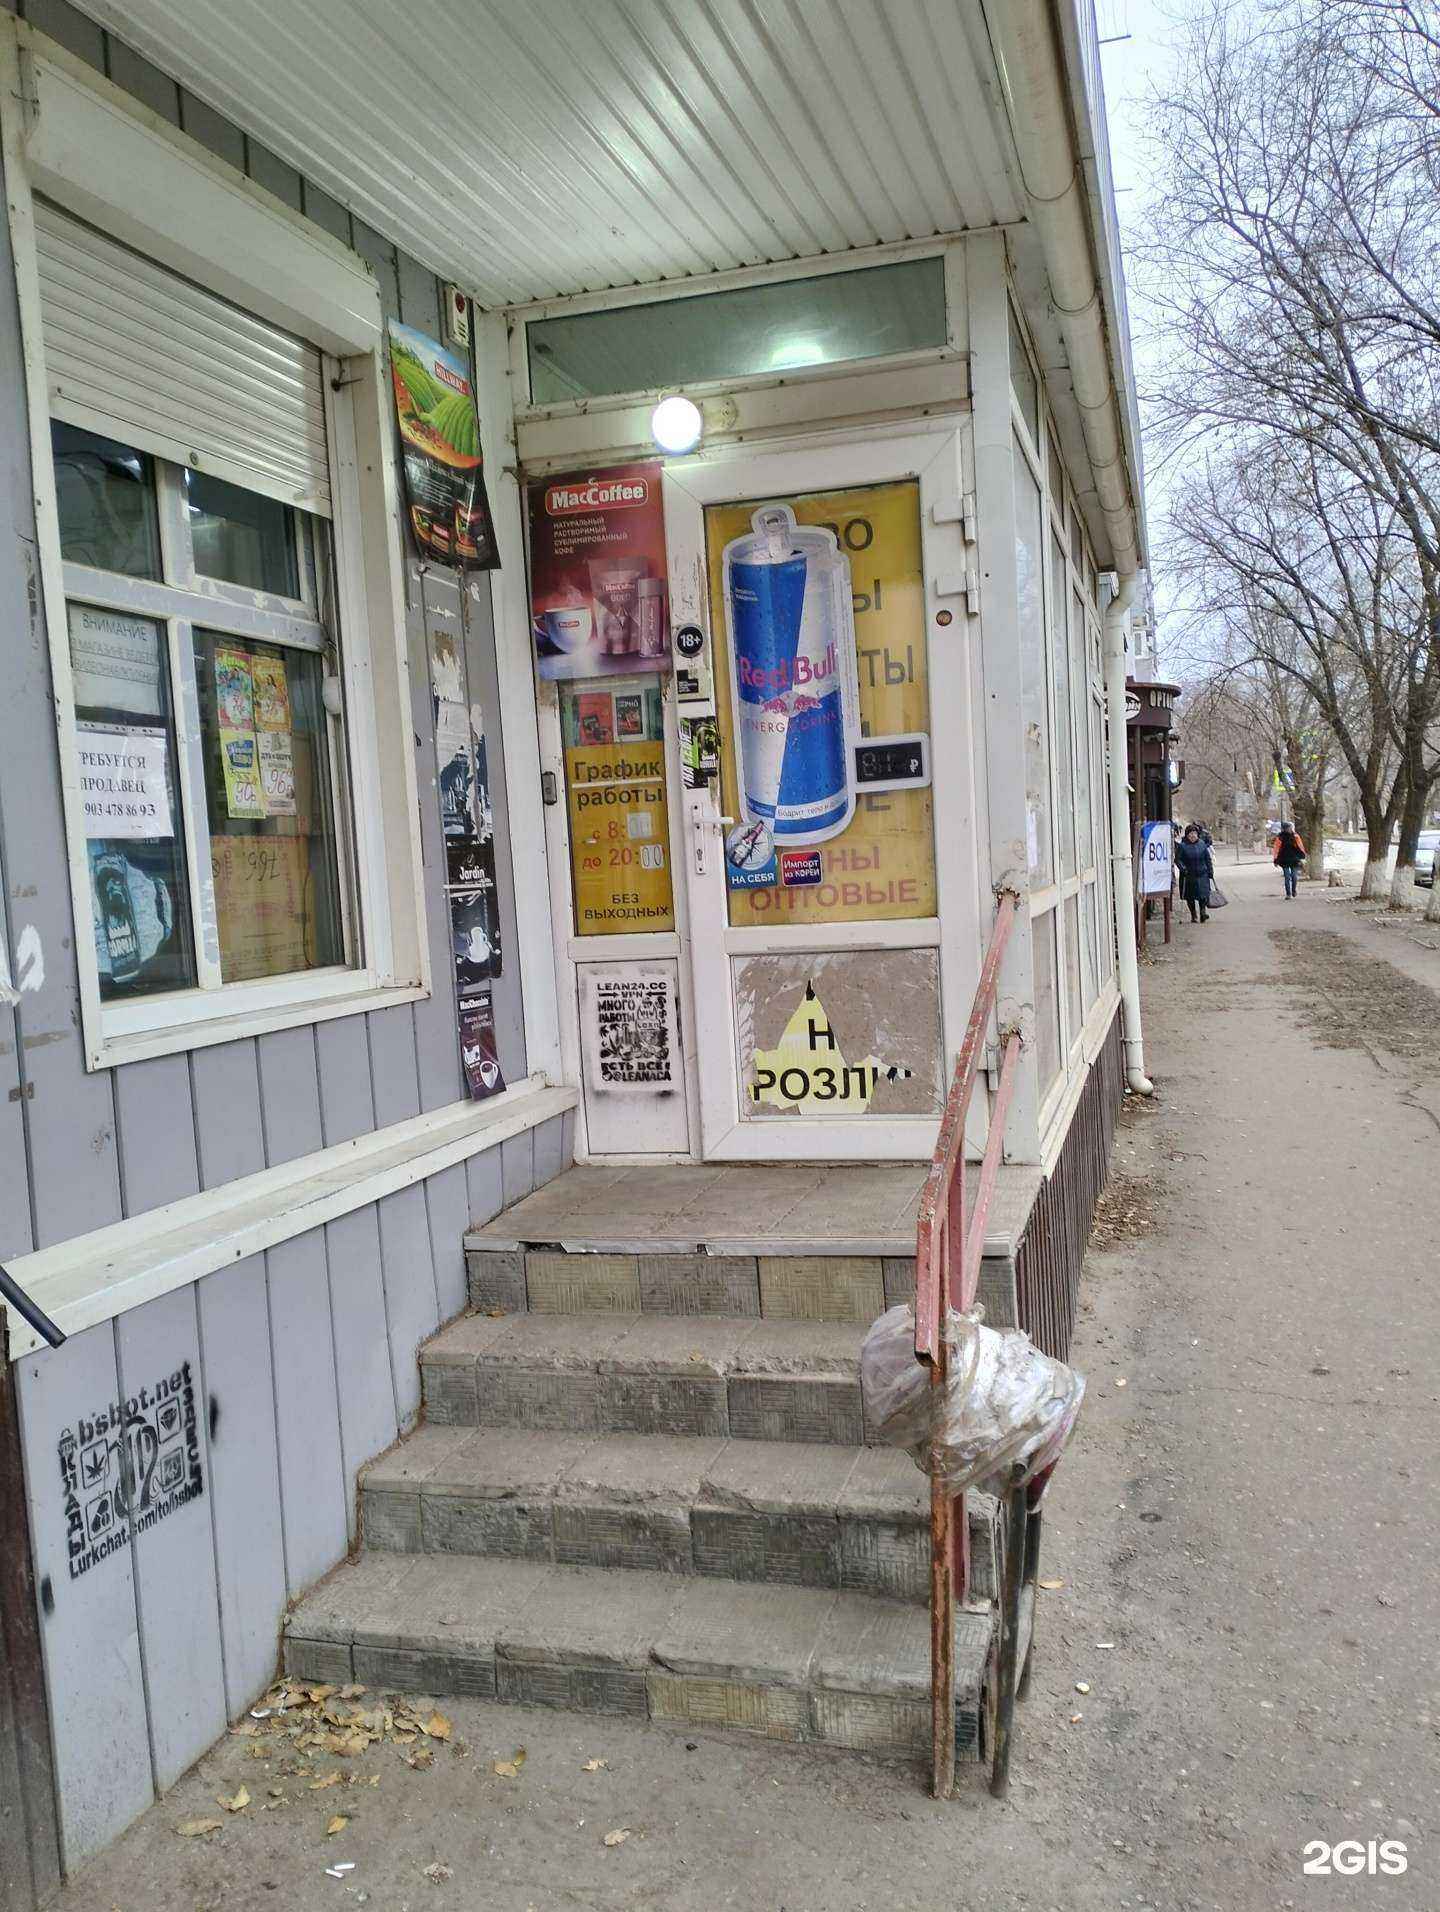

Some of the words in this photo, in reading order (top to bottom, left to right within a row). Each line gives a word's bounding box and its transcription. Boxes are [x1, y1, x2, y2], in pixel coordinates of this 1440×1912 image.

[552, 485, 644, 509] MacCoffee
[553, 518, 605, 529] НАТУРАЛЬНЫЙ
[553, 527, 607, 539] РАСТВОРИМЫЙ
[680, 634, 700, 647] 18+
[739, 656, 787, 688] Red
[793, 642, 836, 685] Bull
[574, 759, 661, 782] График
[577, 785, 663, 811] работы
[85, 803, 103, 816] 903
[105, 803, 123, 816] 478
[126, 804, 138, 816] 86
[140, 803, 156, 816] 93
[583, 857, 601, 871] до
[784, 859, 819, 870] Импорт
[459, 866, 485, 880] Jardin
[732, 875, 746, 884] НА
[747, 872, 775, 883] СЕБЯ
[796, 868, 820, 877] КОРЕИ
[612, 894, 639, 904] БЕЗ
[750, 879, 920, 911] ОПТОВЫЕ
[584, 905, 669, 919] ВЫХОДНЫХ
[598, 1000, 636, 1012] МНОГО
